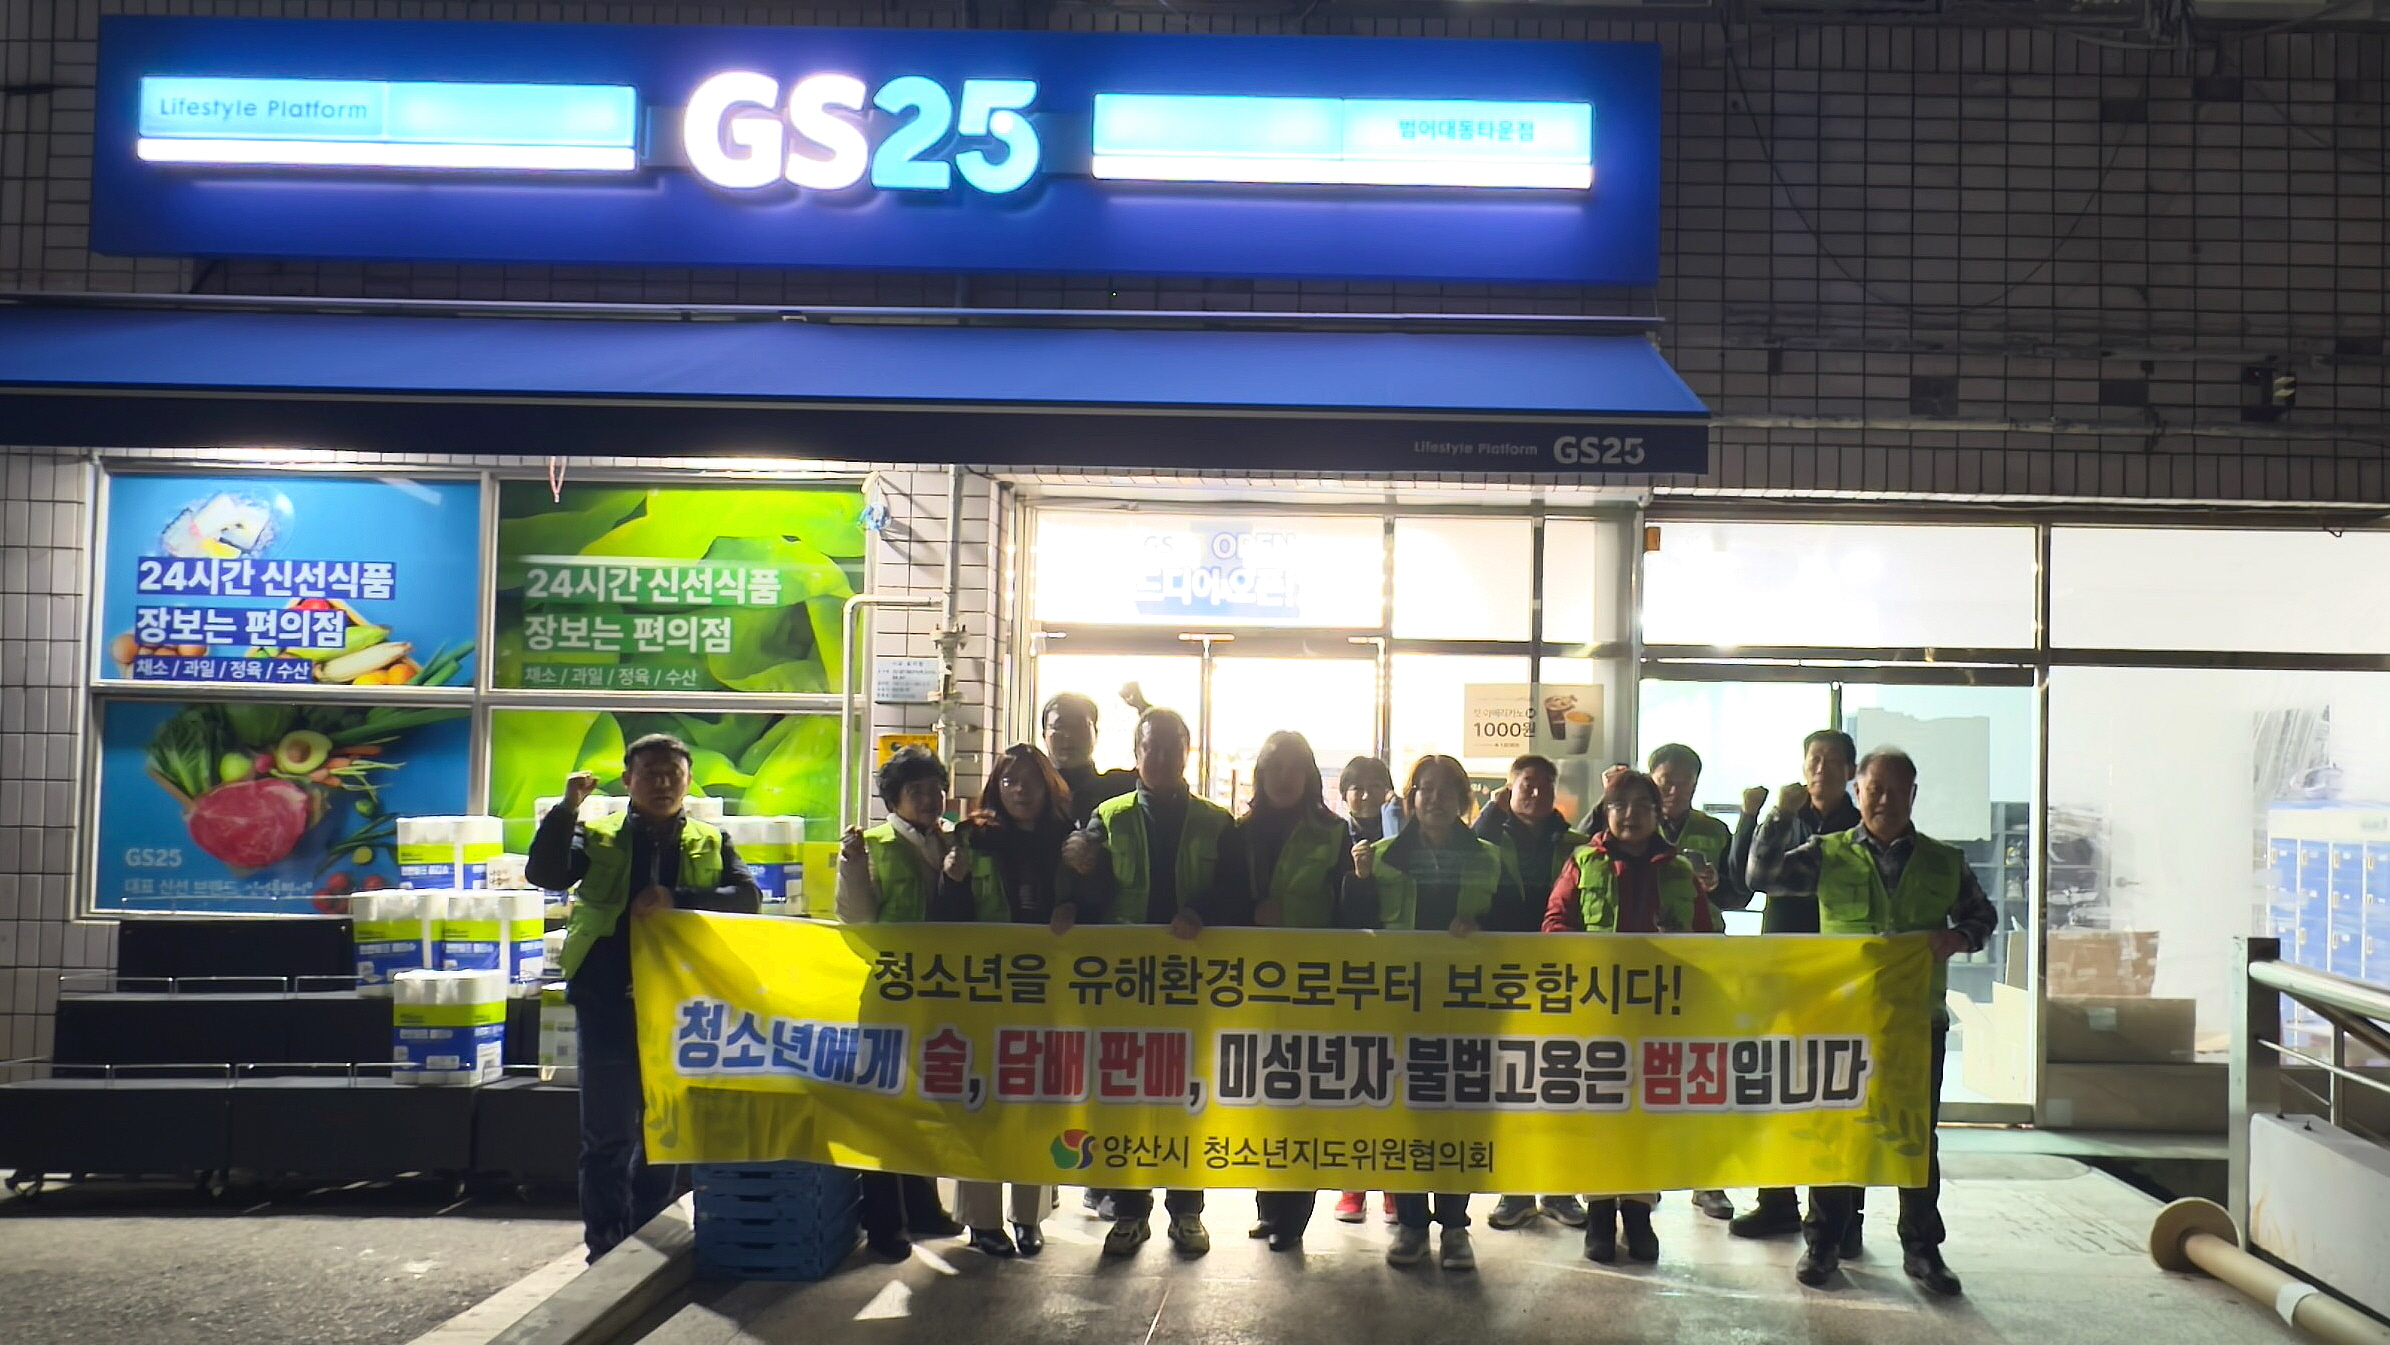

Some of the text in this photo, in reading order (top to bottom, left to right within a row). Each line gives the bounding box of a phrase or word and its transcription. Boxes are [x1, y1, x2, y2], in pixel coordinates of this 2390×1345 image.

[160, 98, 367, 120] Lifestyle Platform
[683, 71, 1041, 193] GS25
[1399, 119, 1534, 142] 범어대동타운점
[1414, 435, 1645, 465] Lifestyle Platform GS25
[138, 559, 395, 599] 24시간 신선식품
[525, 566, 782, 604] 24시간 신선식품
[137, 609, 346, 647] 장보는 편의점
[524, 615, 732, 653] 장보는 편의점
[135, 659, 169, 679] 채소
[183, 659, 215, 679] 과일
[230, 660, 262, 680] 정육
[276, 660, 310, 681] 수산
[524, 667, 557, 686] 채소
[571, 667, 604, 686] 과일
[618, 667, 649, 687] 정육
[665, 667, 697, 687] 수산
[1473, 722, 1536, 737] 1000원
[125, 848, 183, 867] GS25
[874, 952, 1683, 1016] 청소년을 유해환경으로부터 보호합시다!
[678, 999, 1868, 1107] 청소년에게 술, 담배 판매, 미성년자 불법고용은 범죄입니다
[1103, 1134, 1496, 1173] 양산시 청소년지도위원협의회
